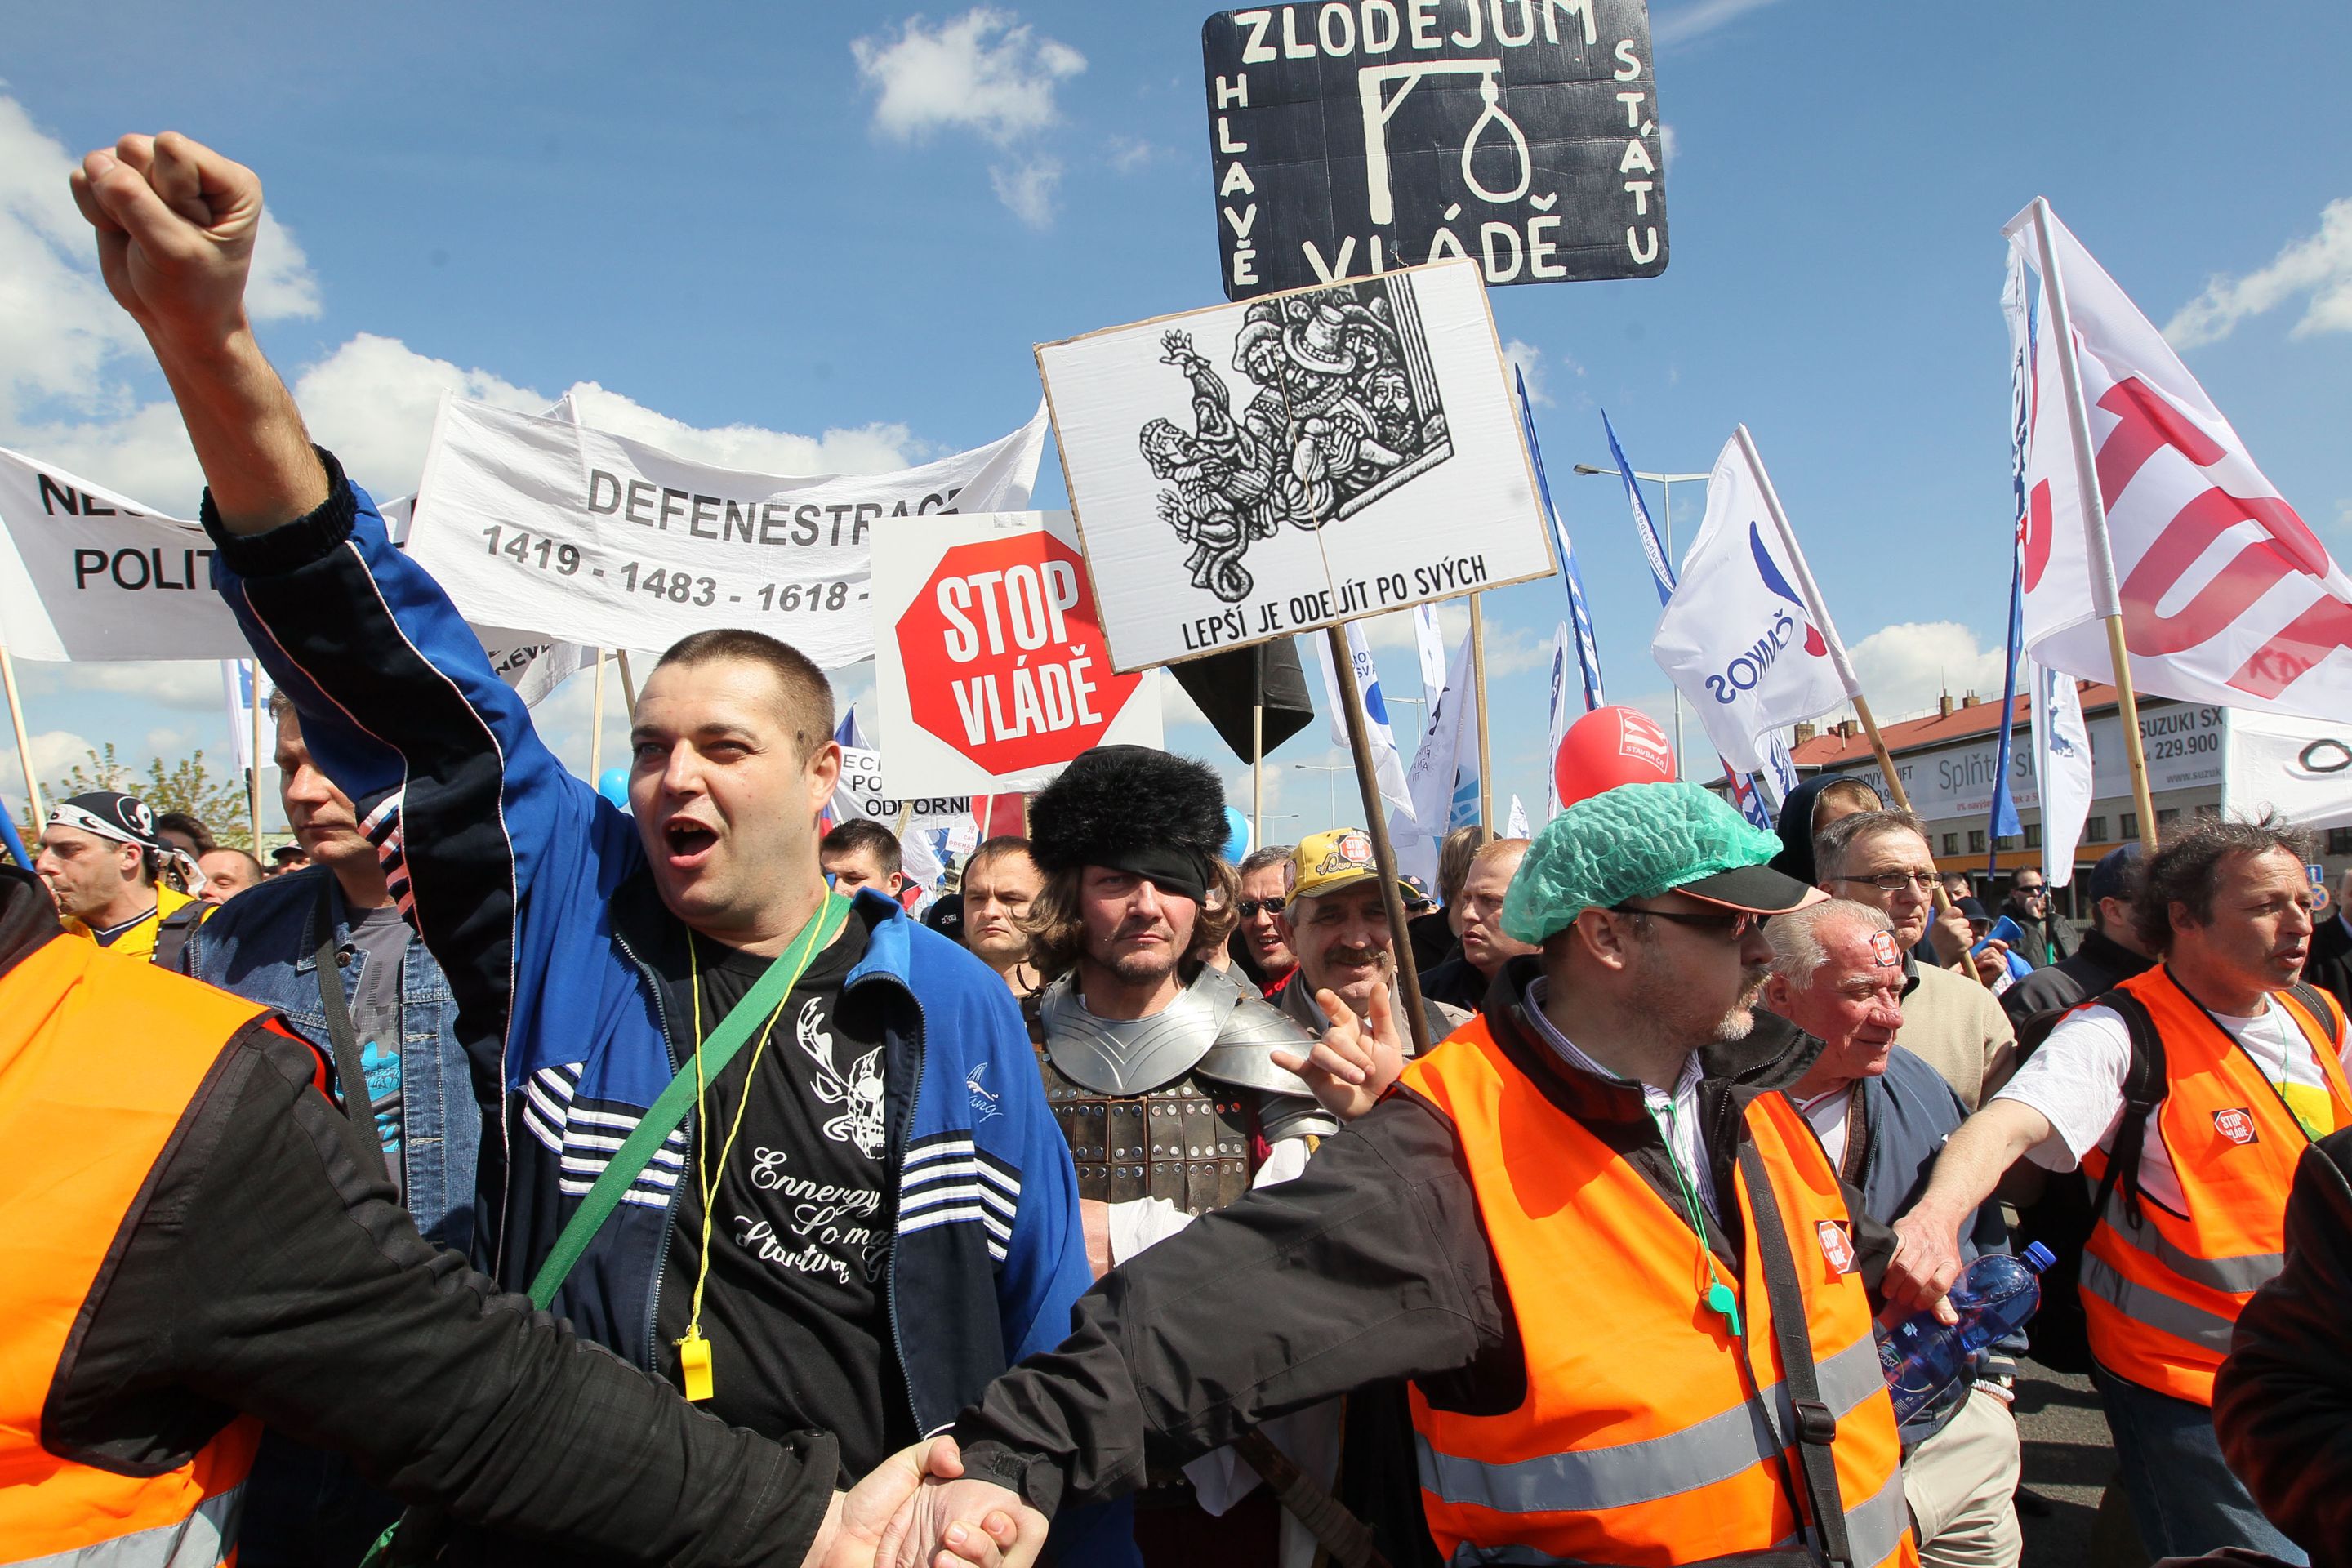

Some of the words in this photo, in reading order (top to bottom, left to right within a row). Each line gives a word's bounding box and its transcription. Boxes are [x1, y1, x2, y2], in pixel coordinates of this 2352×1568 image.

[587, 468, 964, 546] DEFENESTRC
[483, 525, 580, 577] 1419
[620, 560, 717, 607] 1483
[756, 581, 847, 612] 1618
[936, 559, 1079, 663] STOP
[1182, 604, 1247, 650] LEPŠÍ
[1258, 602, 1283, 633] JE
[1376, 572, 1408, 604] PO
[1414, 555, 1488, 596] SVÝCH
[951, 644, 1102, 746] VLÁDĚ
[2139, 711, 2195, 739] SUZUKI
[2156, 733, 2218, 760] 229.900
[1626, 746, 1655, 761] STAVBA
[866, 796, 970, 817] ODORNI
[2220, 1113, 2242, 1129] STOP
